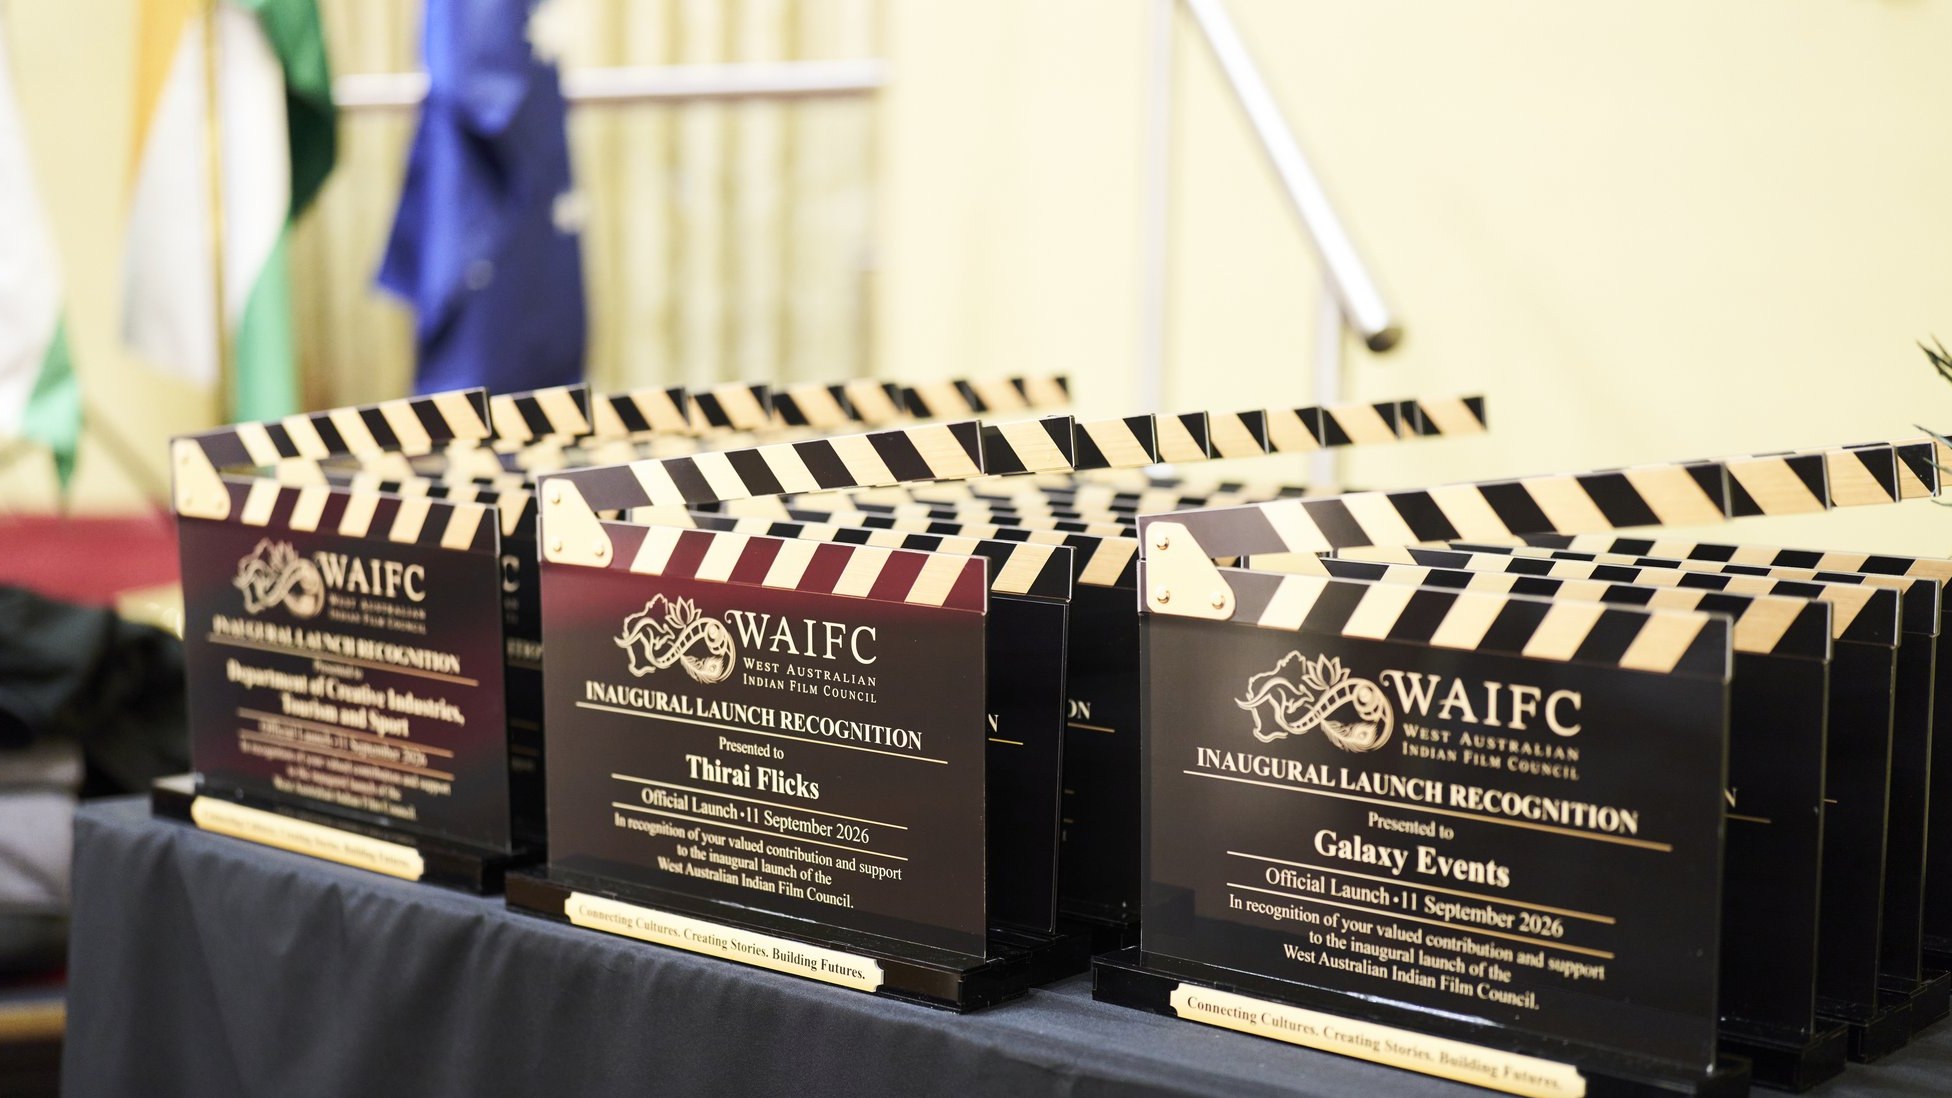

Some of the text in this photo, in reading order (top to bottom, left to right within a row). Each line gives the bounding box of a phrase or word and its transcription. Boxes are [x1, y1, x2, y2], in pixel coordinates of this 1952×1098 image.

[314, 551, 426, 602] WAIFC
[356, 638, 460, 675] RECOGNITION
[724, 609, 877, 665] WAIFC
[226, 658, 308, 690] Department
[743, 657, 877, 687] WEST AUSTRALIAN
[743, 673, 877, 704] INDIAN FILM COUNCIL
[585, 680, 922, 750] INAUGURAL LAUNCH RECOGNITION
[1379, 669, 1582, 737] WAIFC
[719, 736, 784, 760] Presented to
[1402, 722, 1580, 762] WEST AUSTRALIAN
[1402, 741, 1580, 781] INDIAN FILM COUNCIL
[685, 754, 820, 800] Thirai Flicks
[1196, 746, 1639, 835] INAUGURAL LAUNCH RECOGNITION
[641, 787, 688, 811] Official
[691, 797, 738, 820] Launch
[746, 807, 759, 824] 11
[764, 810, 833, 837] September
[836, 823, 870, 844] 2026
[1368, 811, 1454, 840] Presented to
[614, 812, 902, 880] In recognition of your valued contribution and support
[677, 844, 832, 885] to the inaugural launch of the
[1313, 829, 1510, 888] Galaxy Events
[657, 856, 854, 909] West Australian Indian Film Council.
[1265, 867, 1325, 893] Official
[1330, 878, 1390, 905] Launch
[1401, 891, 1417, 910] 11
[1424, 895, 1515, 929] September
[1518, 911, 1564, 938] 2026
[579, 905, 865, 980] Connecting Cultures. Creating Stories. Building Futures.
[1229, 893, 1605, 981] In recognition of your valued contribution and support
[1309, 931, 1512, 983] to the inaugural launch of the
[1283, 943, 1540, 1010] West Australian Indian Film Council.
[1187, 995, 1257, 1024] Connecting
[1261, 1012, 1319, 1037] Cultures.
[1323, 1025, 1381, 1052] Creating
[1385, 1039, 1434, 1062] Stories.
[1440, 1051, 1498, 1078] Building
